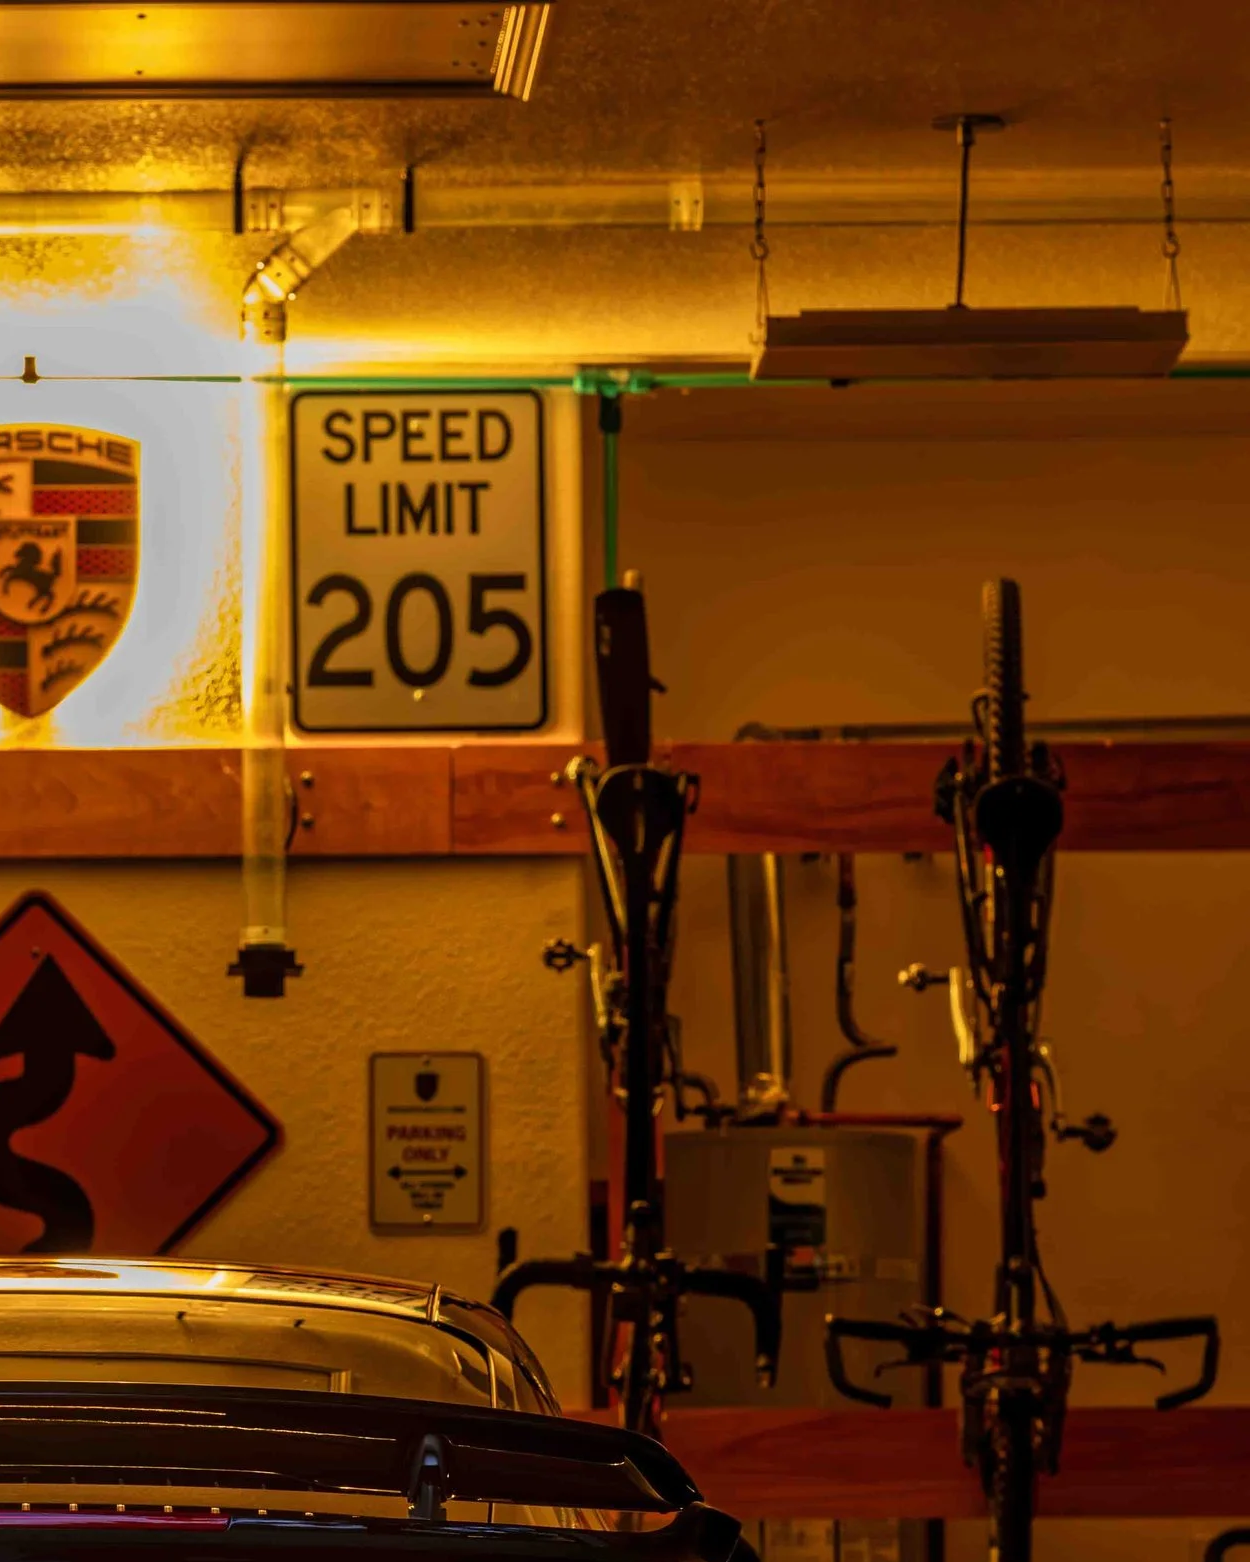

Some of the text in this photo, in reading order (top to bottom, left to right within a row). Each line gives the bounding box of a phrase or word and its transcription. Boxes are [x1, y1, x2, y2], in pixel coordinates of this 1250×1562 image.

[321, 409, 512, 463] SPEED
[344, 481, 492, 535] LIMIT
[306, 571, 533, 688] 205
[386, 1124, 467, 1141] PARKING
[403, 1147, 450, 1161] ONLY
